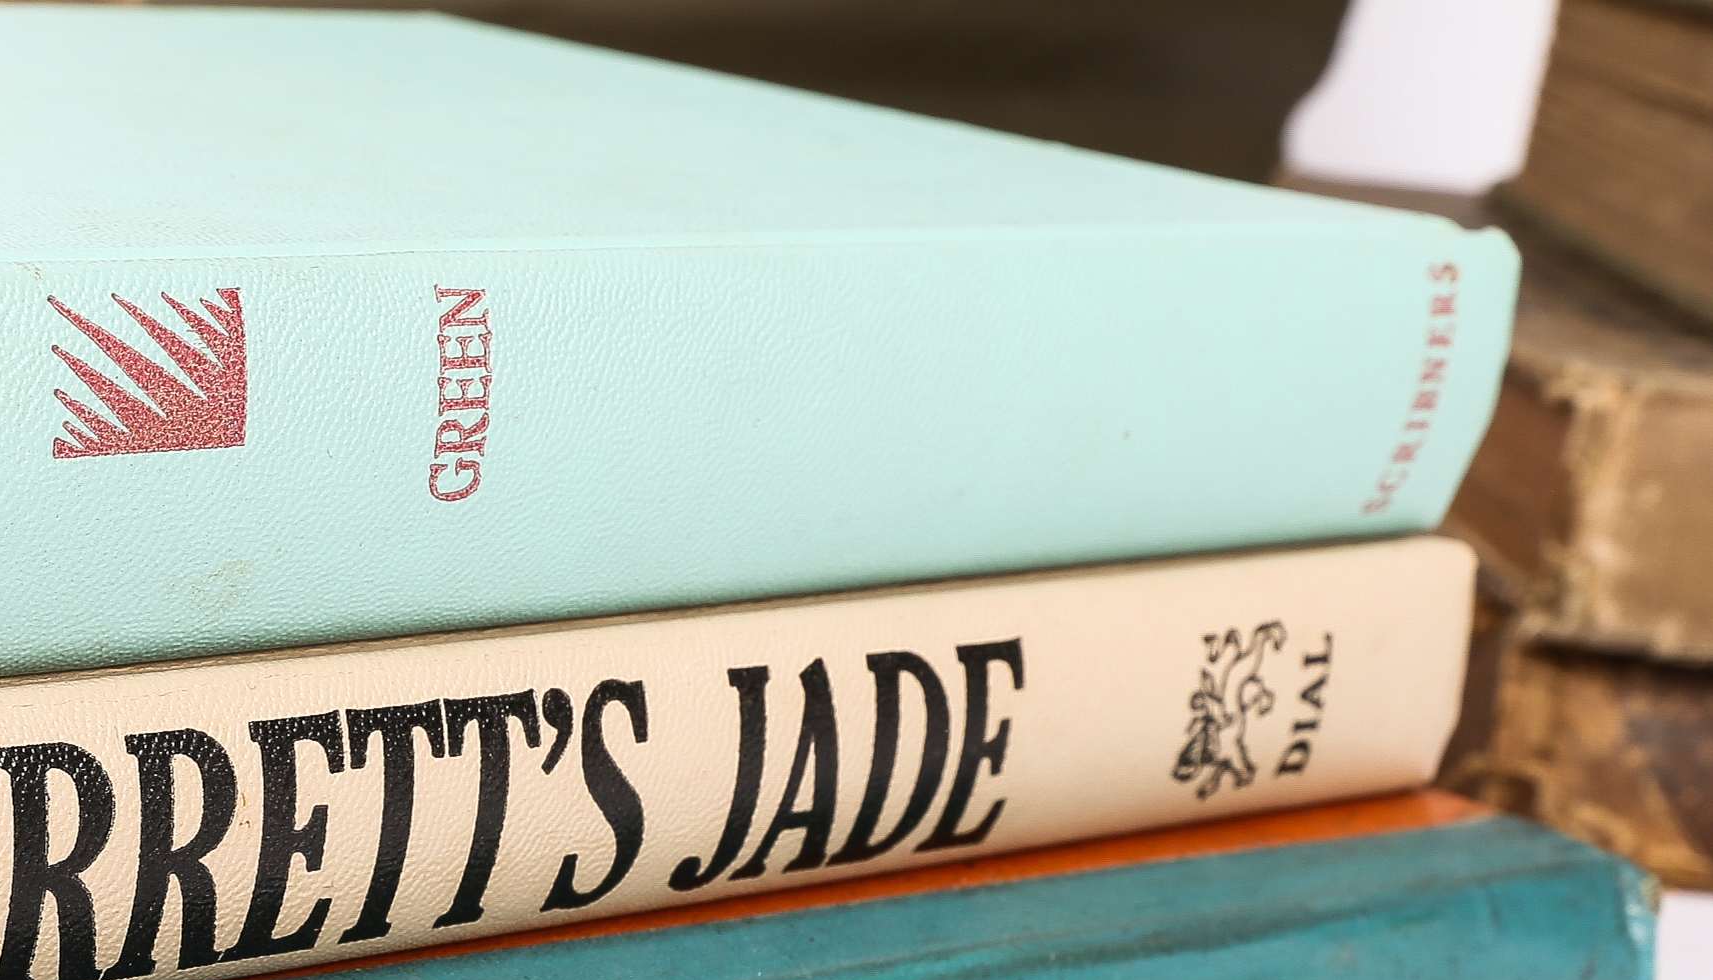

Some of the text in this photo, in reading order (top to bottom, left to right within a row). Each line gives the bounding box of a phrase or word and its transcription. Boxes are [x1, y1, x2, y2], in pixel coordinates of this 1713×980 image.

[429, 284, 492, 501] GREEN
[1362, 262, 1459, 515] SCRIBNERS
[669, 639, 1025, 892] JADE
[1274, 631, 1333, 776] DIAL
